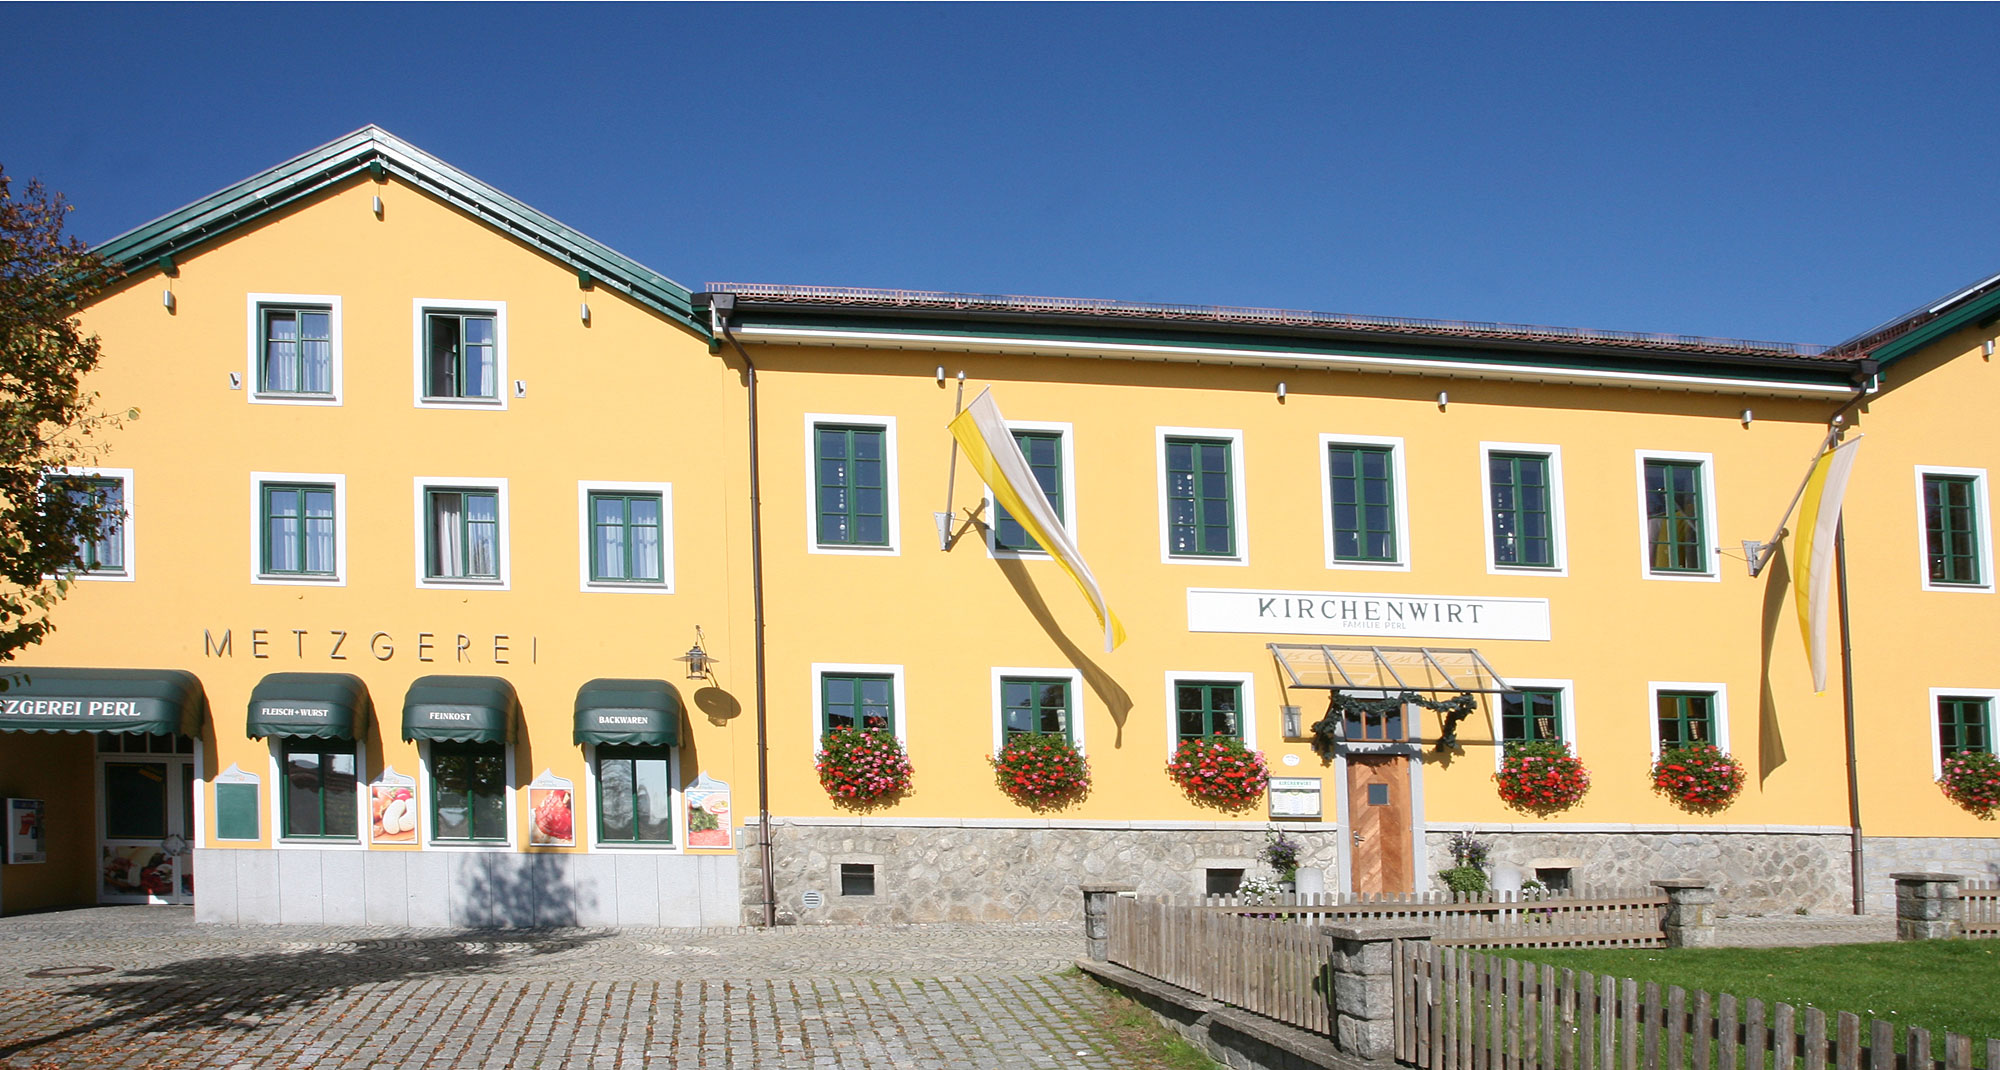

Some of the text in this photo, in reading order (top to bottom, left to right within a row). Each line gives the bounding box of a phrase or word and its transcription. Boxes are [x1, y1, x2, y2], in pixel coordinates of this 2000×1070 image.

[1258, 598, 1483, 623] KIRCHENWIRT
[1342, 621, 1380, 629] FAMILIE
[204, 629, 537, 664] METZGEREI
[88, 702, 141, 716] PERL
[429, 712, 471, 720] FEINKOST
[599, 716, 648, 724] BACKWAREN
